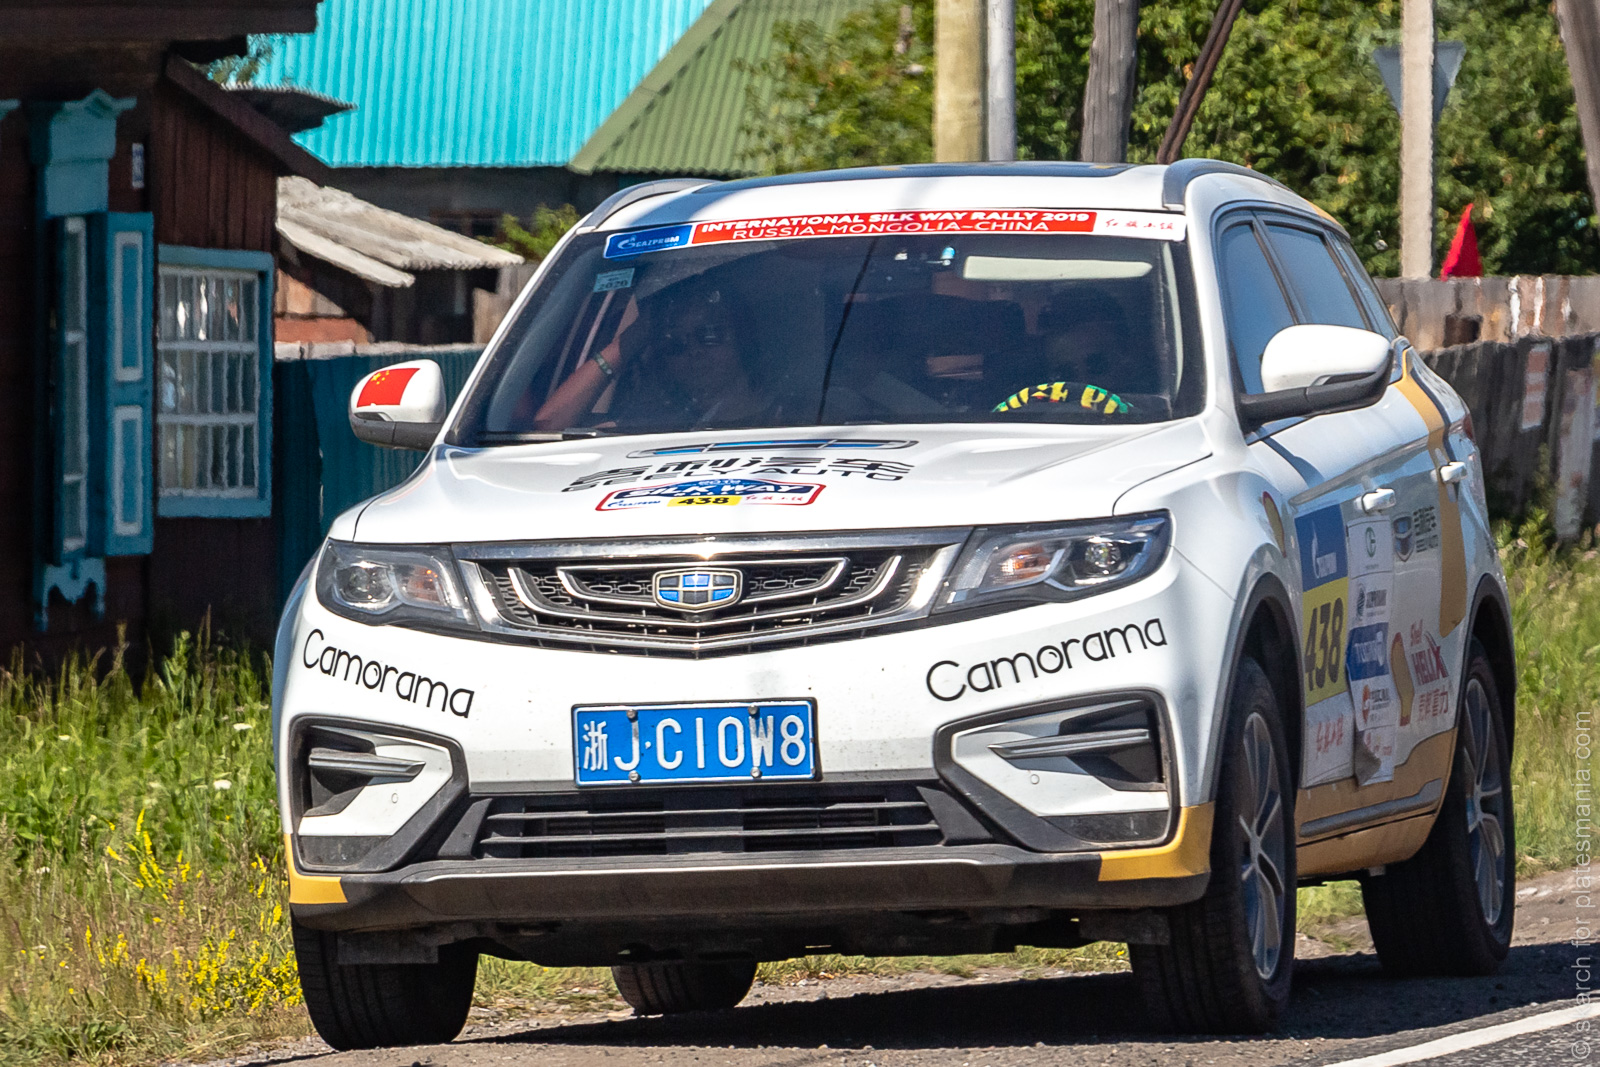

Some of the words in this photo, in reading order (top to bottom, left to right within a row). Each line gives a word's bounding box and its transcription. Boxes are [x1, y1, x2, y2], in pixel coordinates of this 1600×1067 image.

[701, 213, 863, 233] INTERNATIONAL
[869, 211, 916, 224] SILK
[918, 211, 969, 222] WAY
[970, 211, 1039, 222] RALLY
[1042, 211, 1091, 223] 2019
[749, 467, 905, 482] AUTO
[622, 485, 717, 498] SILK
[720, 484, 803, 493] WAY
[677, 497, 731, 505] 438
[926, 617, 1168, 702] Camorama
[1304, 596, 1345, 692] 438
[302, 628, 476, 719] Camorama
[1410, 643, 1449, 686] HELIX
